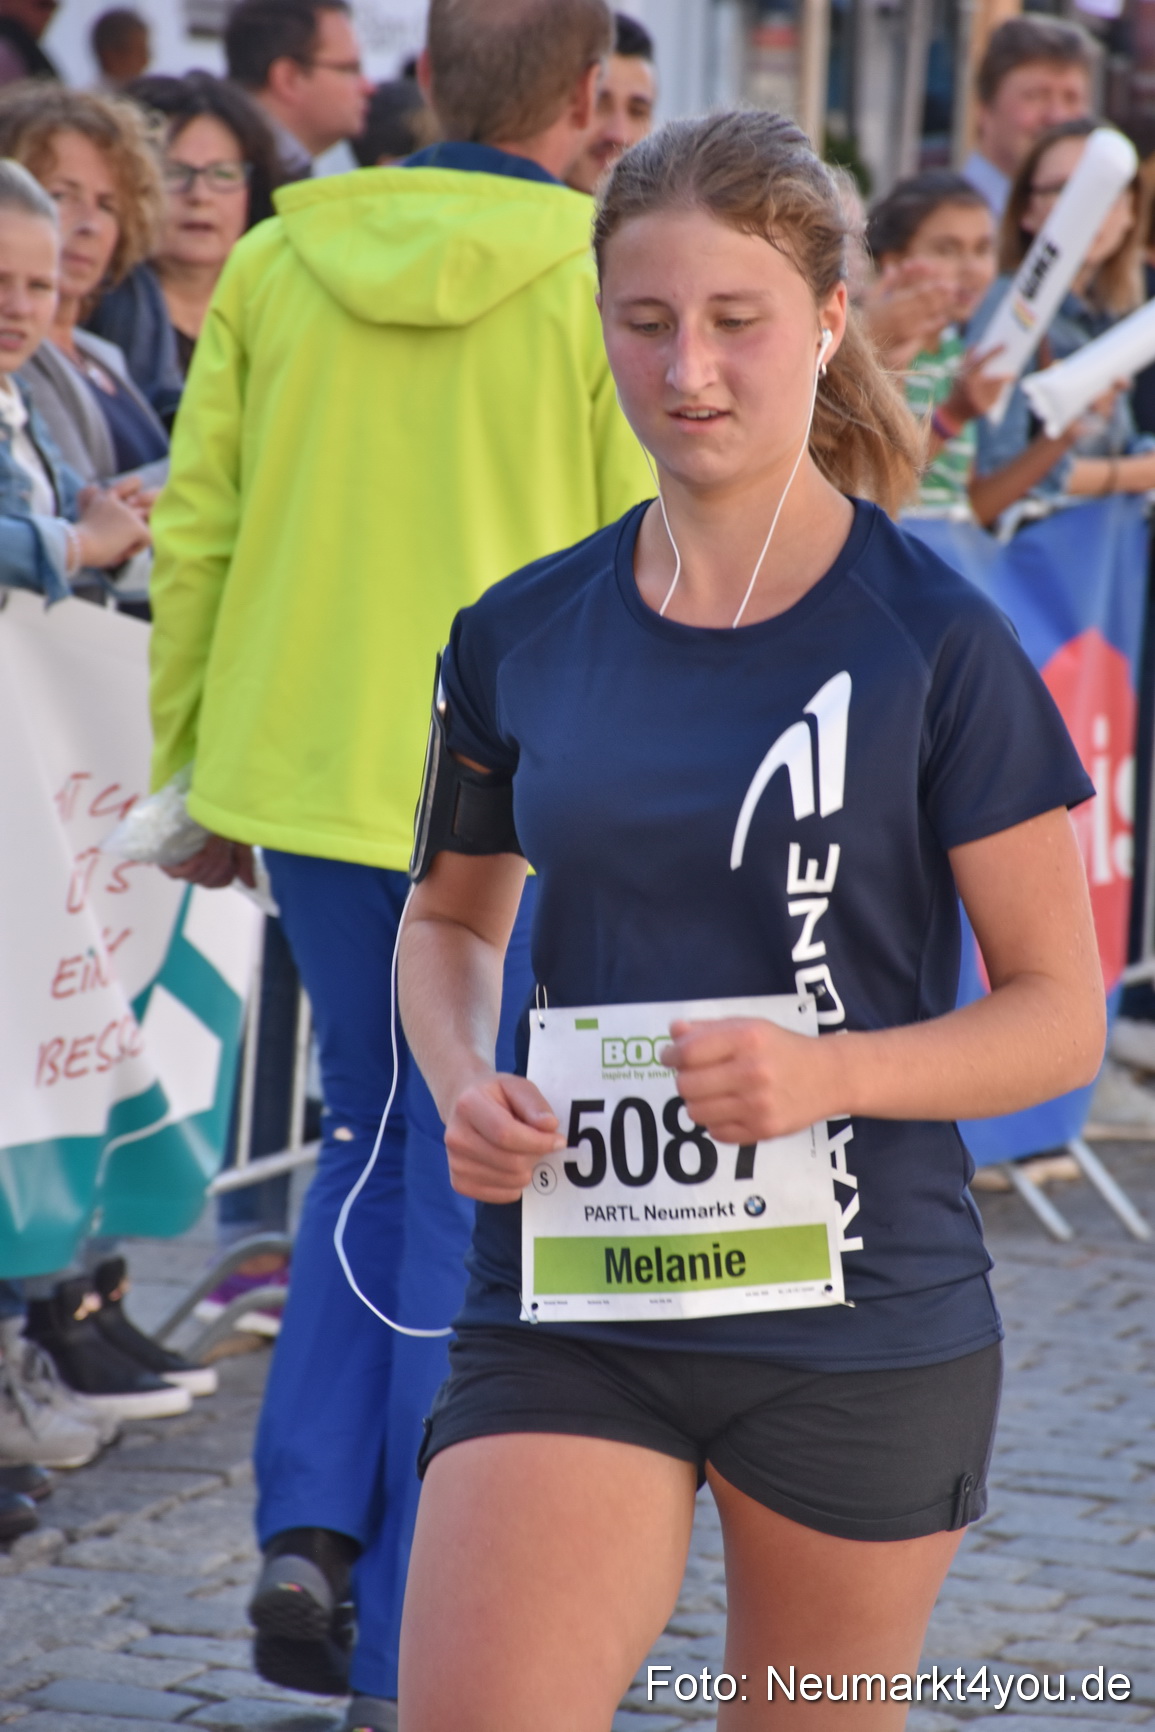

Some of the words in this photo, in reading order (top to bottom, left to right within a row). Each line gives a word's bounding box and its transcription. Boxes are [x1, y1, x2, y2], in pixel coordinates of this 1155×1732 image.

[602, 1070, 632, 1082] inspired
[633, 1069, 645, 1081] by
[539, 1170, 549, 1188] S
[584, 1205, 640, 1222] PARTL
[644, 1201, 736, 1221] Neumarkt
[604, 1243, 747, 1285] Melanie
